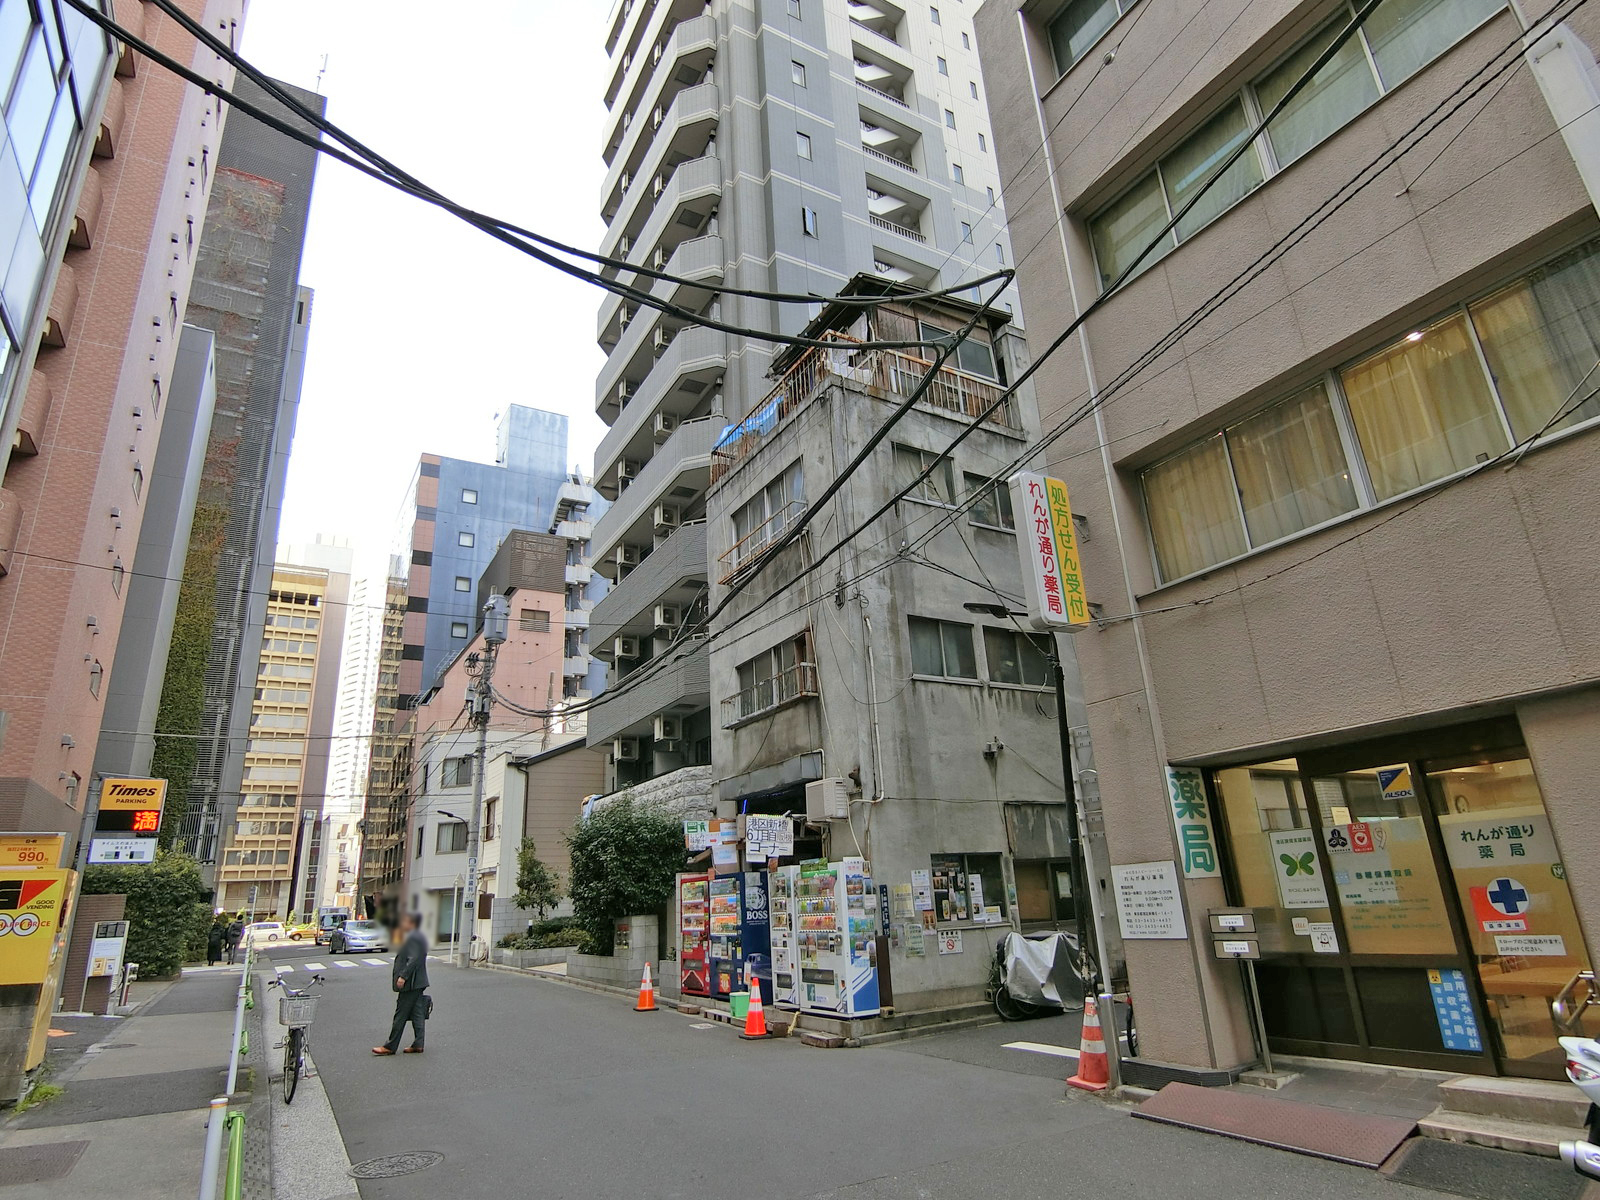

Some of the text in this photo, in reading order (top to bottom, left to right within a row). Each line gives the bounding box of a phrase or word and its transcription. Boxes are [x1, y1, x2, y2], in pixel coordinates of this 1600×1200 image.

[1028, 480, 1063, 615] れんが通り薬局
[1051, 485, 1084, 618] 処方せん受付
[109, 784, 158, 797] Times
[1385, 790, 1413, 798] ALSOK
[134, 812, 159, 830] 満
[749, 818, 789, 831] 港区新橋
[1169, 771, 1216, 874] 薬局
[1460, 824, 1534, 842] れんが通り
[750, 841, 788, 854] コーナー
[1478, 843, 1526, 859] 薬局
[18, 851, 44, 862] 990
[746, 910, 768, 920] BOSS
